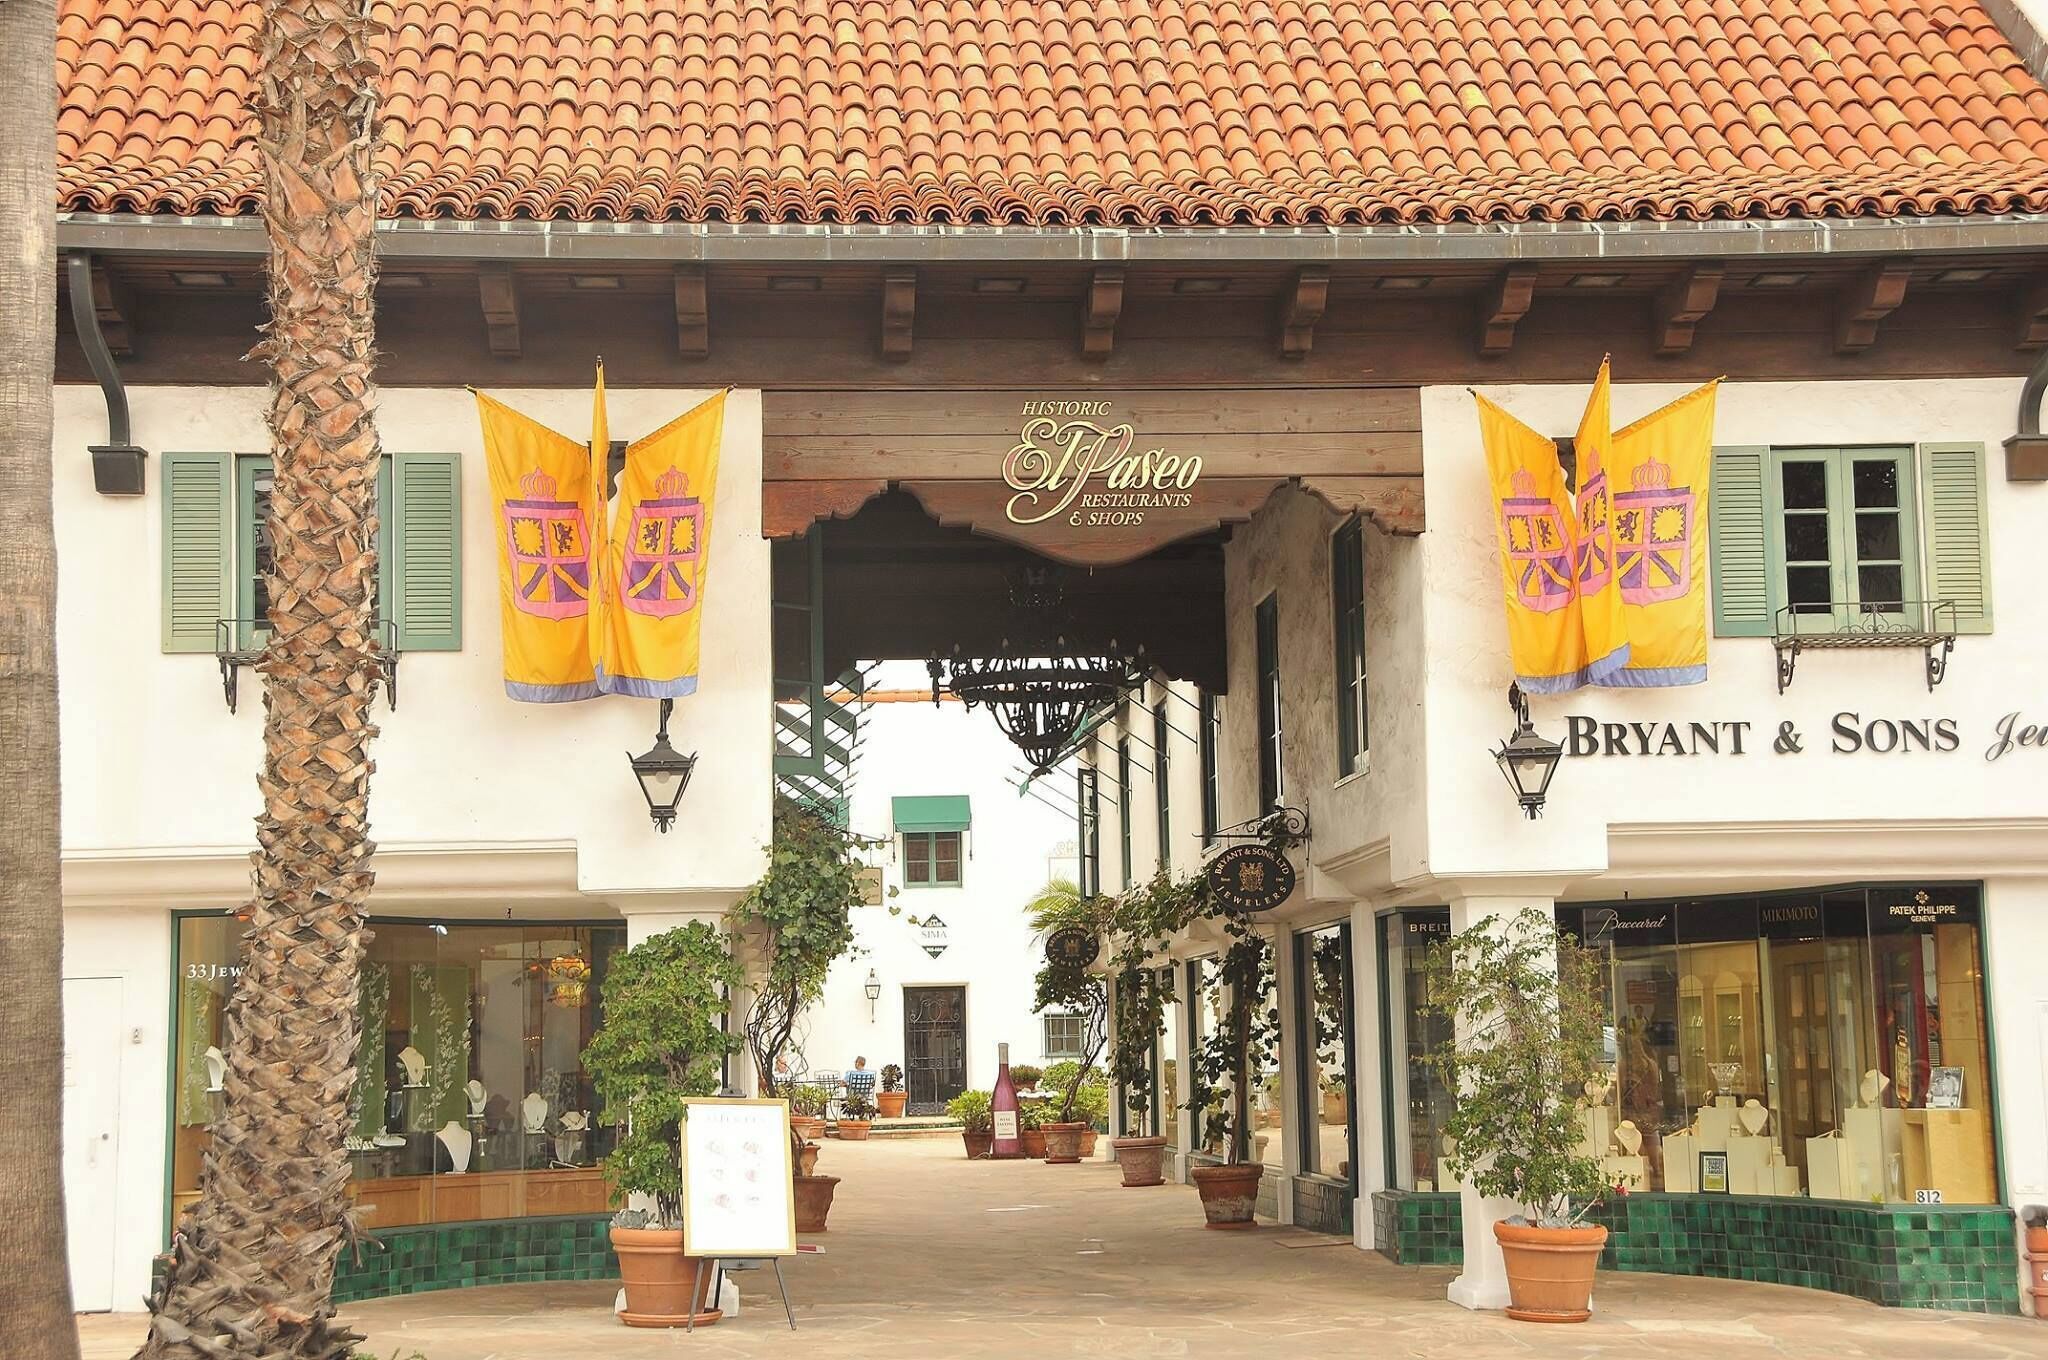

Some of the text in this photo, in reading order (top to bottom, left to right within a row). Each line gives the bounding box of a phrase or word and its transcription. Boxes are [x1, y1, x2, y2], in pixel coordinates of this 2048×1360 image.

[1021, 401, 1112, 416] HISTORIC
[1002, 417, 1204, 525] El Paseo
[1080, 493, 1193, 508] RESTAURANTS
[1069, 511, 1145, 527] & SHOPS
[1564, 715, 1751, 757] BRYANT
[1773, 720, 1804, 754] &
[1831, 712, 1960, 753] SONS
[1214, 848, 1243, 875] BRYANT
[1216, 885, 1287, 907] JEWELERS
[1762, 906, 1818, 923] MIKIMOTO
[1889, 905, 1956, 915] PATEK PHILIPPE
[1409, 922, 1449, 932] BREIT
[1593, 908, 1668, 941] Baccarat
[187, 963, 244, 982] 33 JEW
[1916, 1190, 1941, 1203] 812
